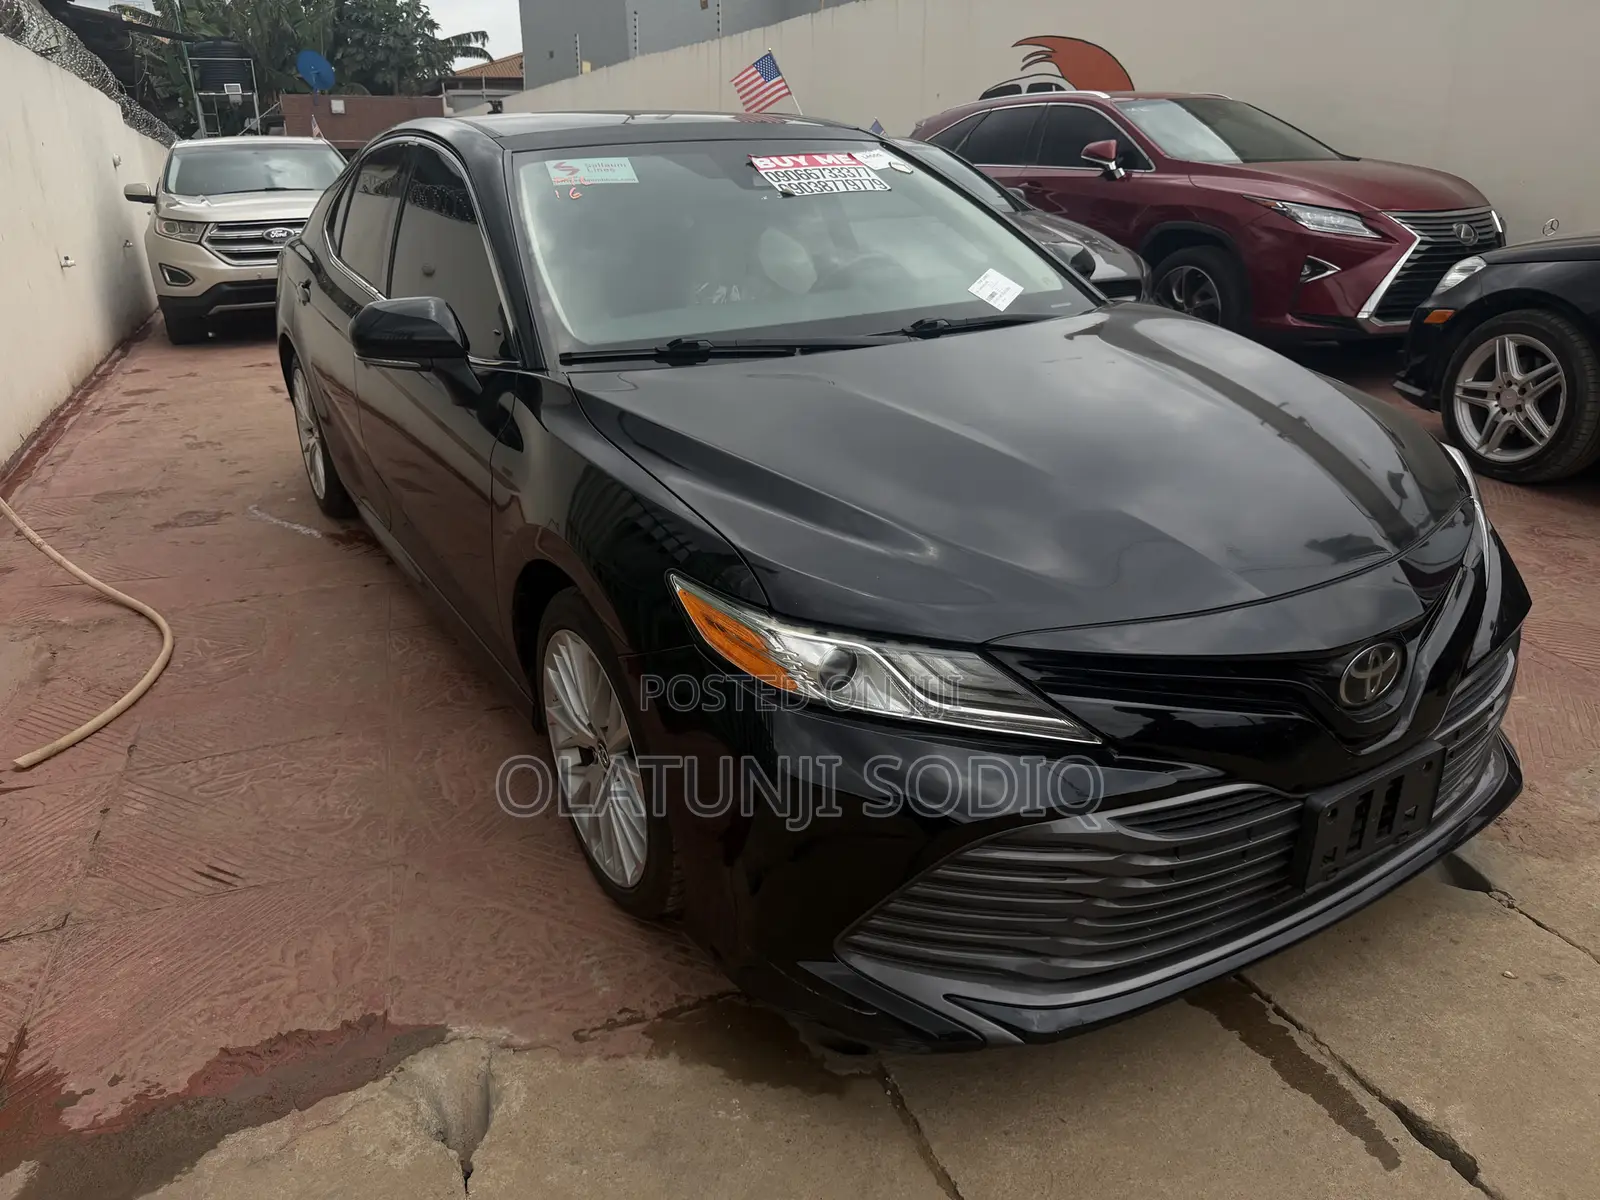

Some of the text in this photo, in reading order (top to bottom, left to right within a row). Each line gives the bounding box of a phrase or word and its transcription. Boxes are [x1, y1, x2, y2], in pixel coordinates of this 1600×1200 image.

[753, 155, 809, 169] BUY
[814, 154, 857, 166] ME
[764, 167, 871, 183] 09066733377
